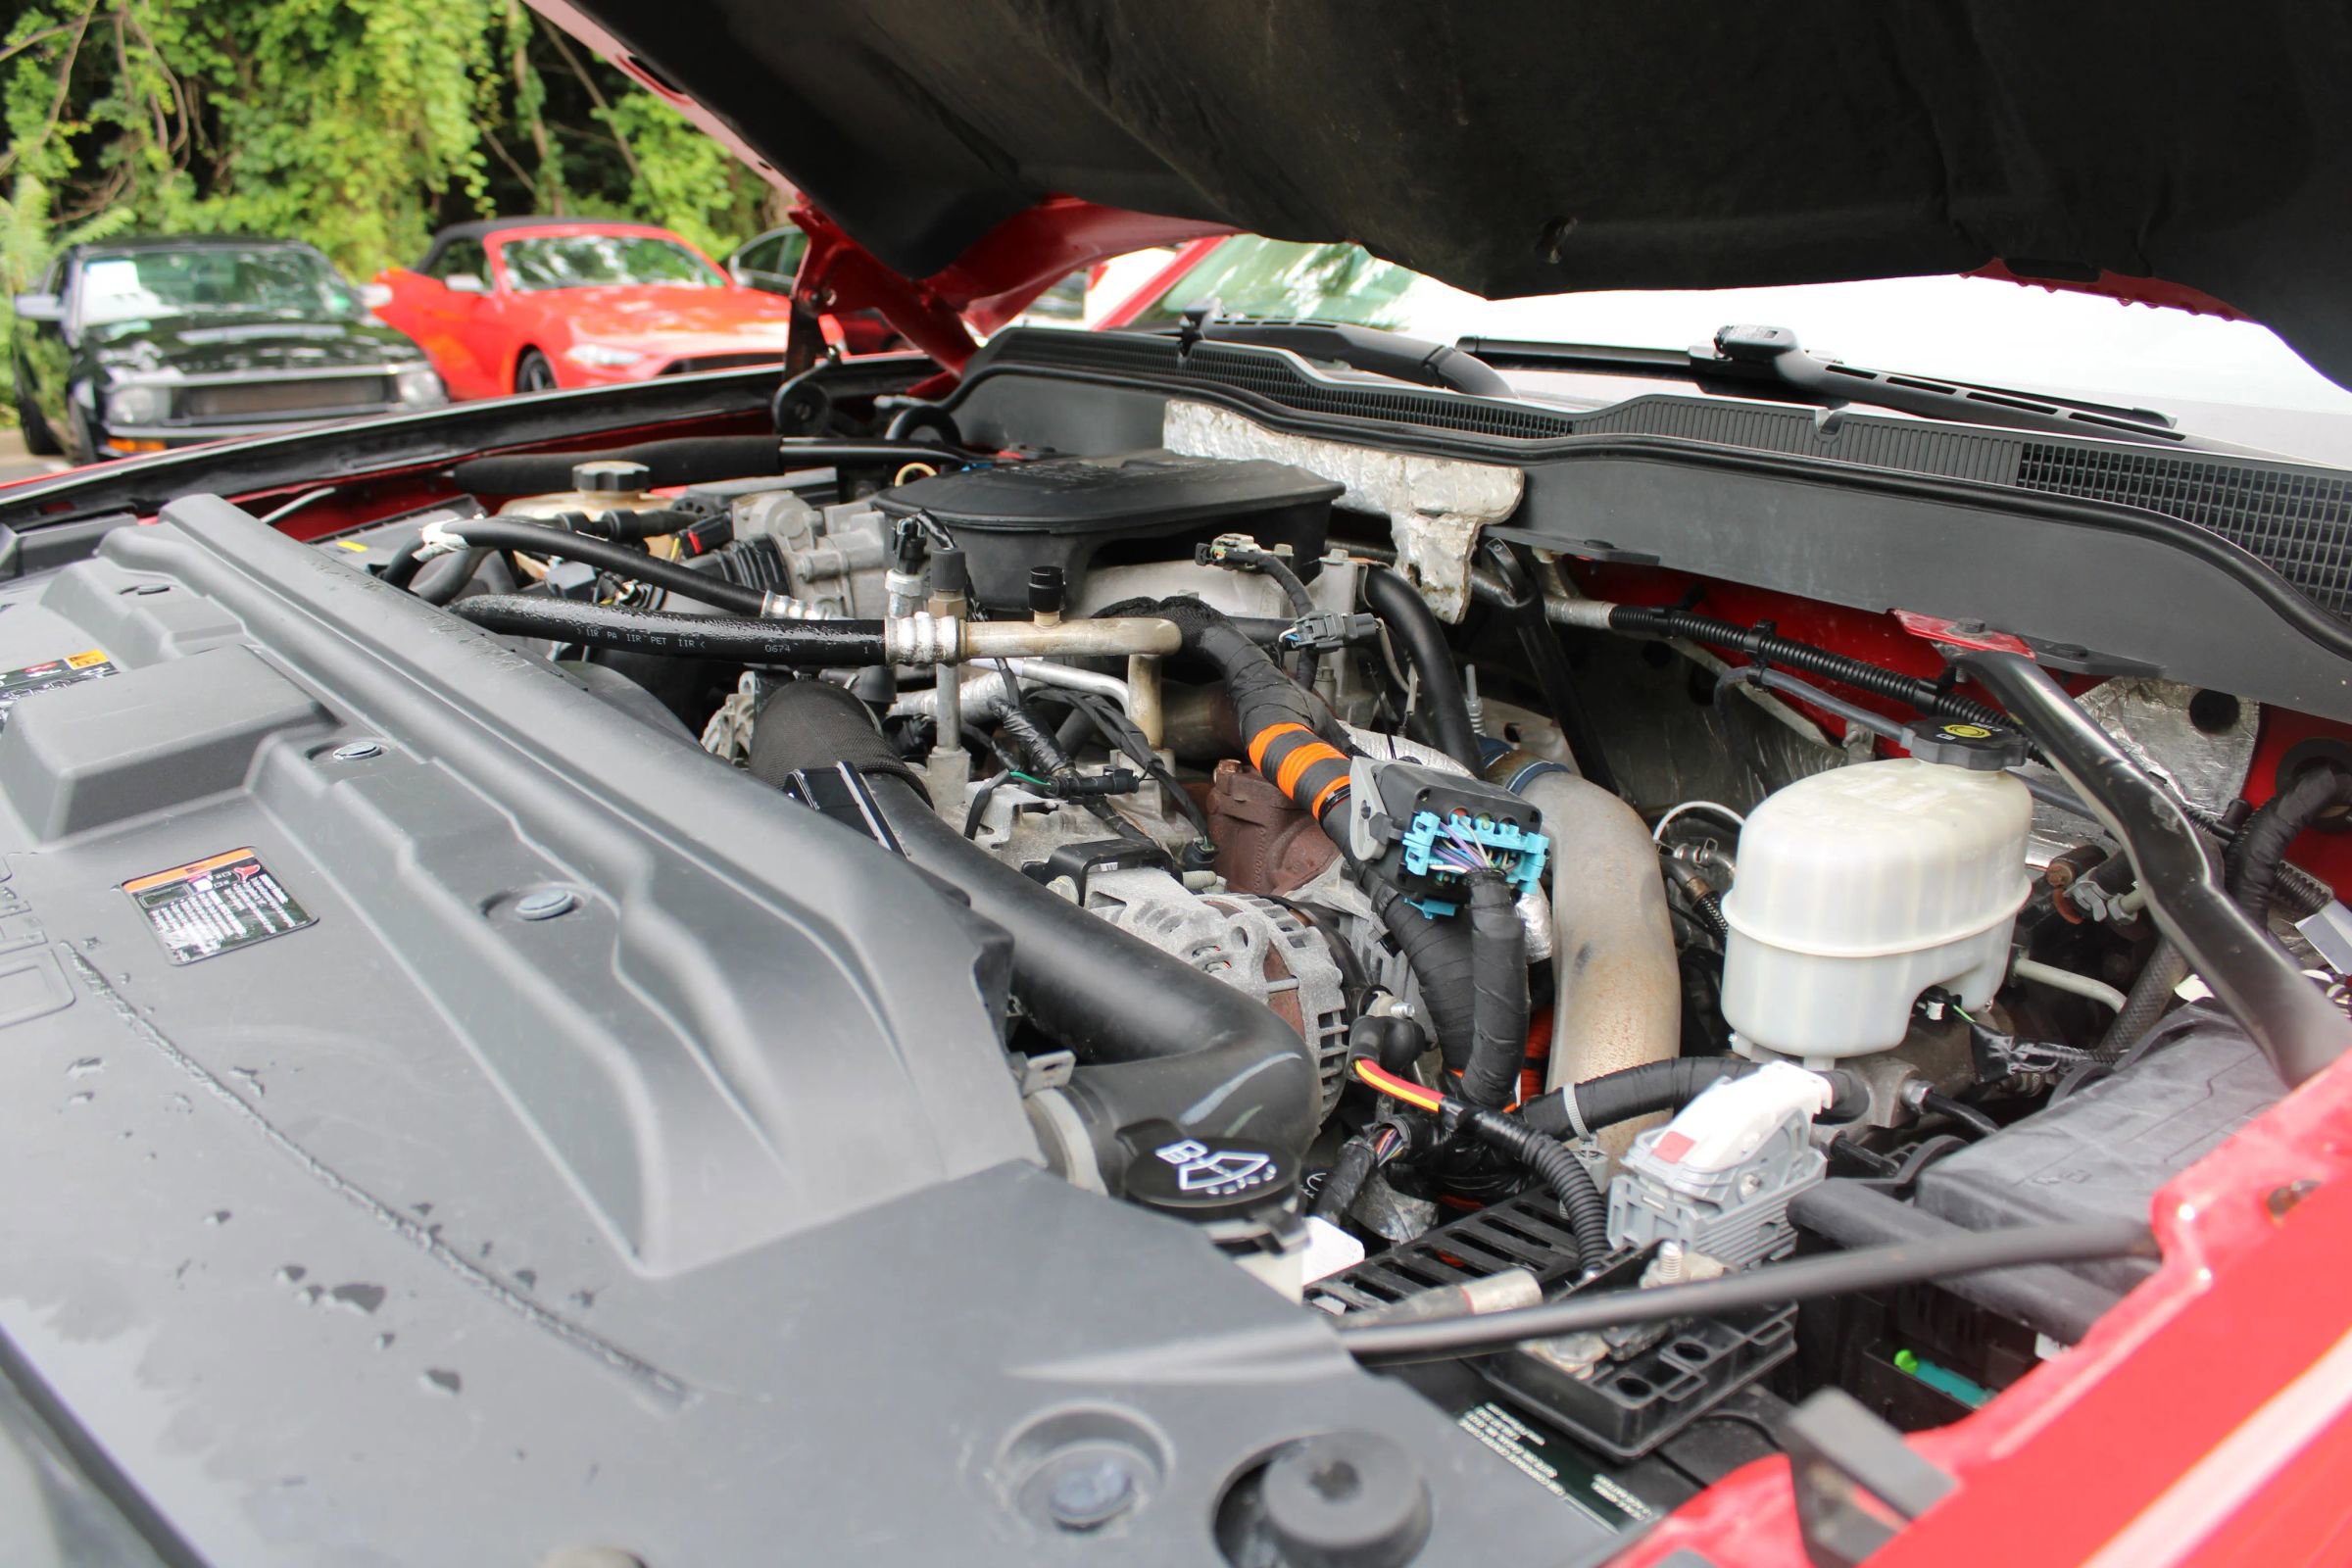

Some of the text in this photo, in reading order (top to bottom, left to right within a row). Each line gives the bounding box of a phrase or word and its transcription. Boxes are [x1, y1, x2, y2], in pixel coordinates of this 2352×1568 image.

[626, 633, 641, 643] IIR
[650, 636, 666, 646] PET
[678, 638, 695, 648] IIR
